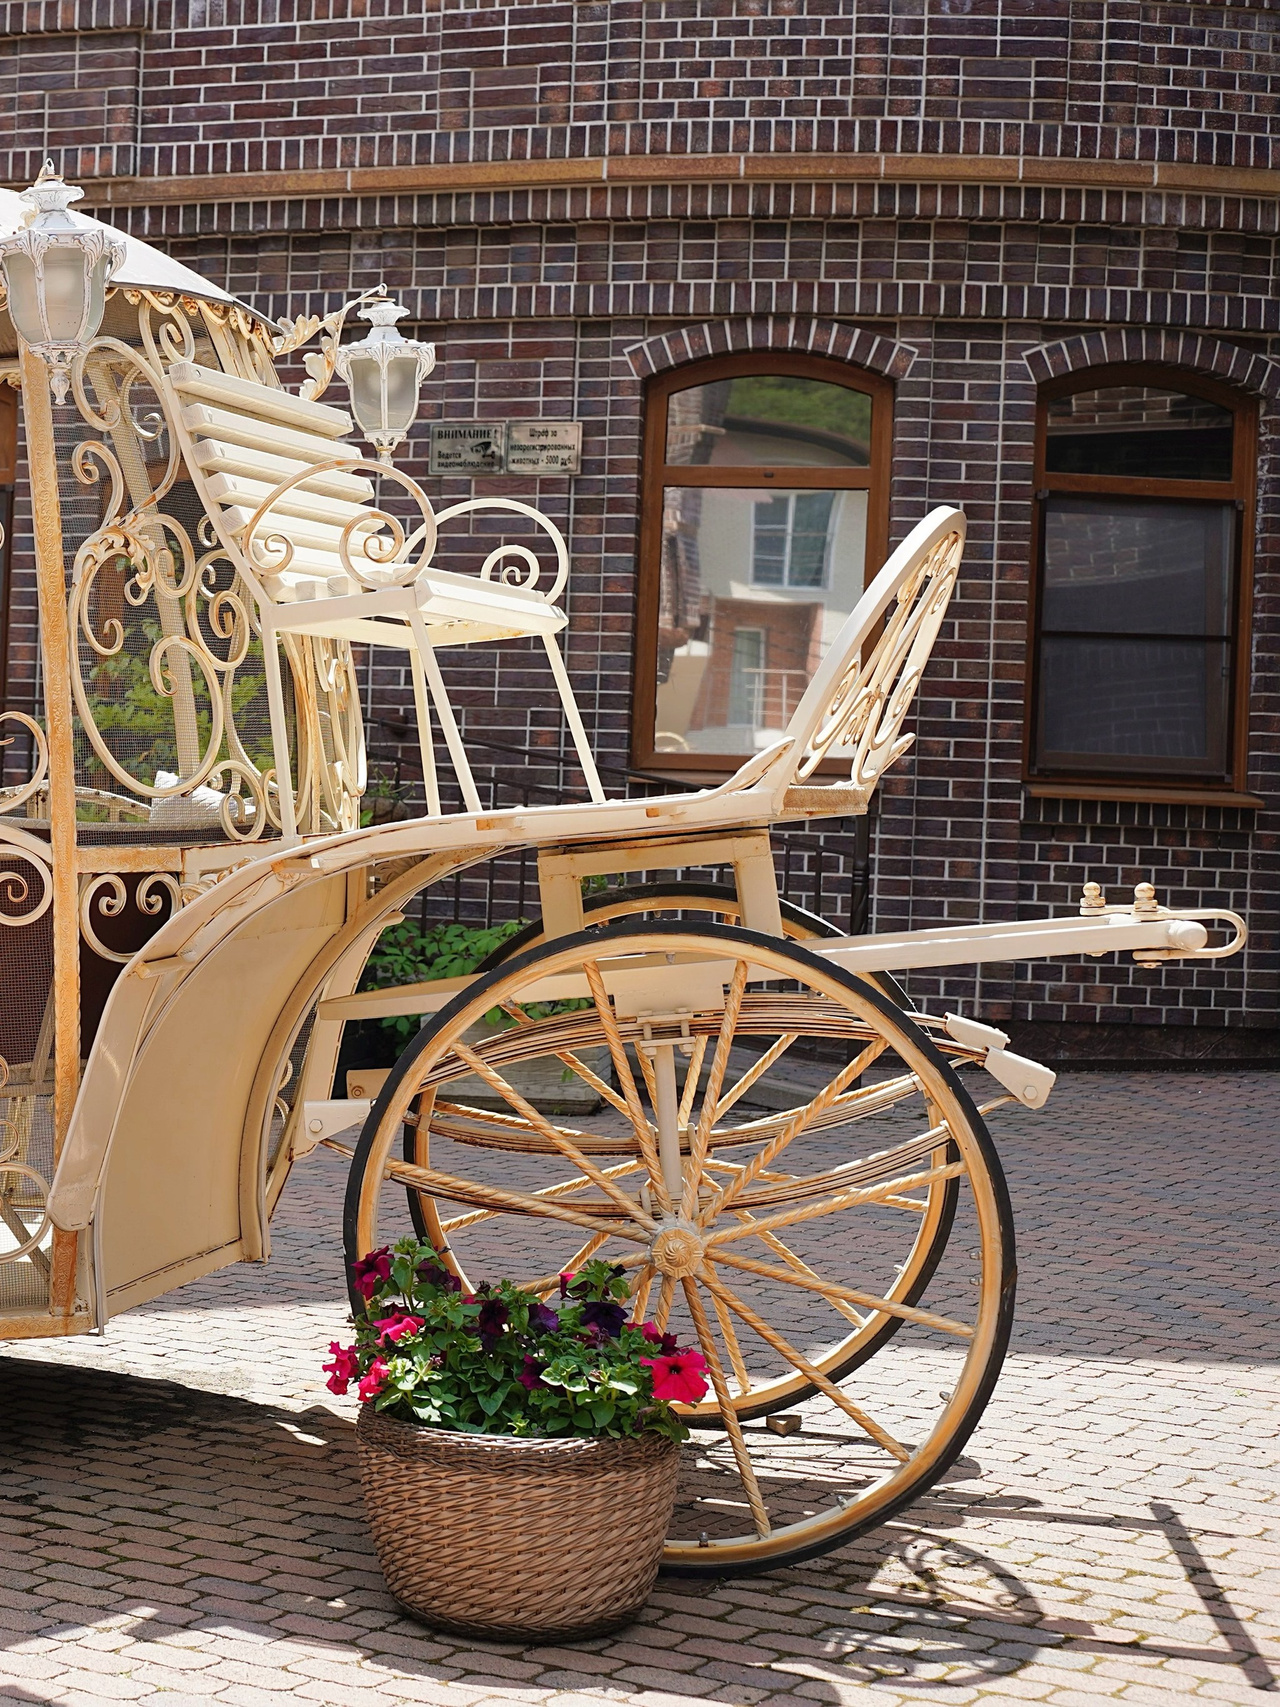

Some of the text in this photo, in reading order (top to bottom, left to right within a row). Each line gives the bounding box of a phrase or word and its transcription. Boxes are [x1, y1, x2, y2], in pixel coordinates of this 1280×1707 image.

[529, 428, 549, 440] Штраф
[509, 444, 576, 452] незарегистрированных
[437, 459, 495, 468] видеонаблюдение
[545, 455, 559, 465] 5000
[560, 455, 574, 467] руб.
